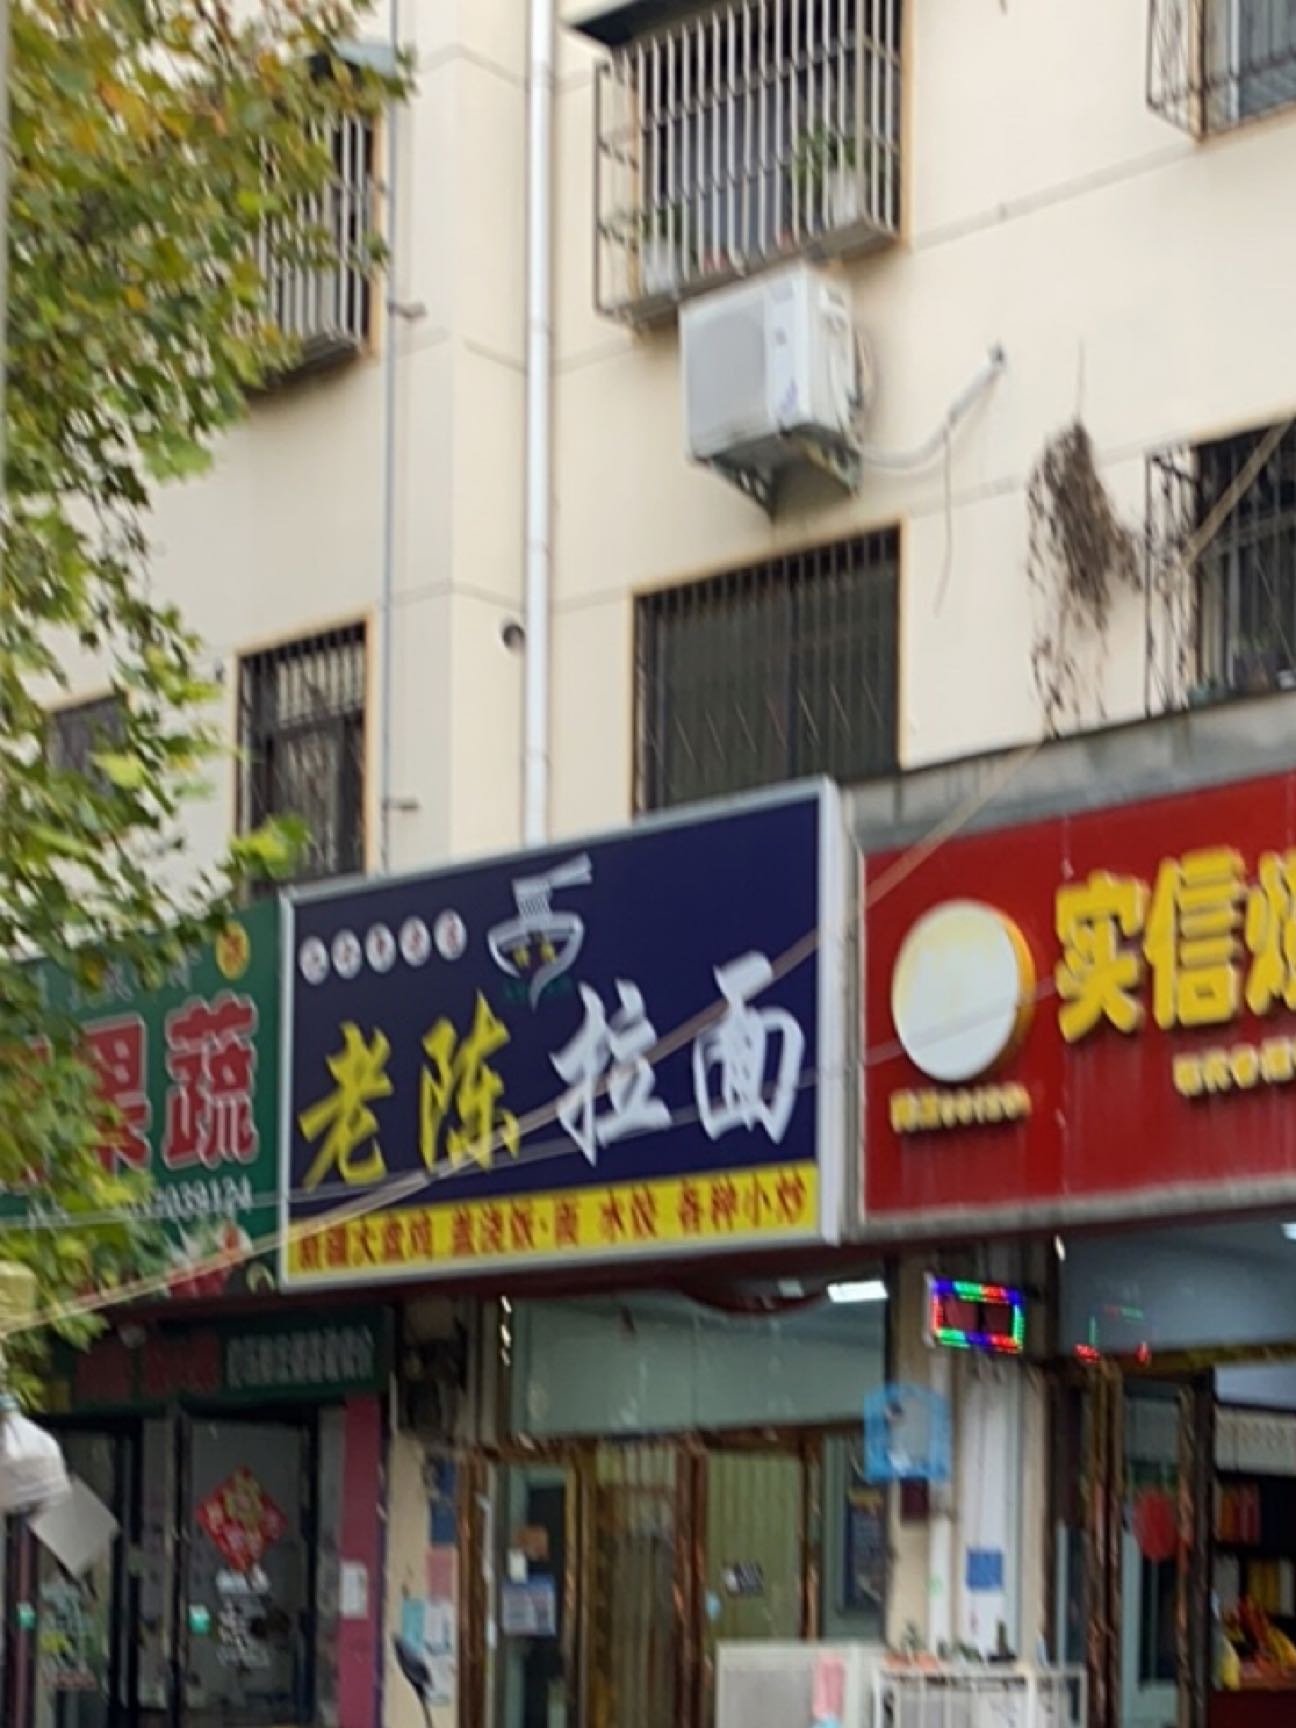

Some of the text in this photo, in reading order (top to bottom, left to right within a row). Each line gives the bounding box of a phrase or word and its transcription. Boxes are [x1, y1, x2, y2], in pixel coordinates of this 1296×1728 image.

[298, 951, 805, 1191] 老陈拉面
[600, 1182, 658, 1244] 水饺
